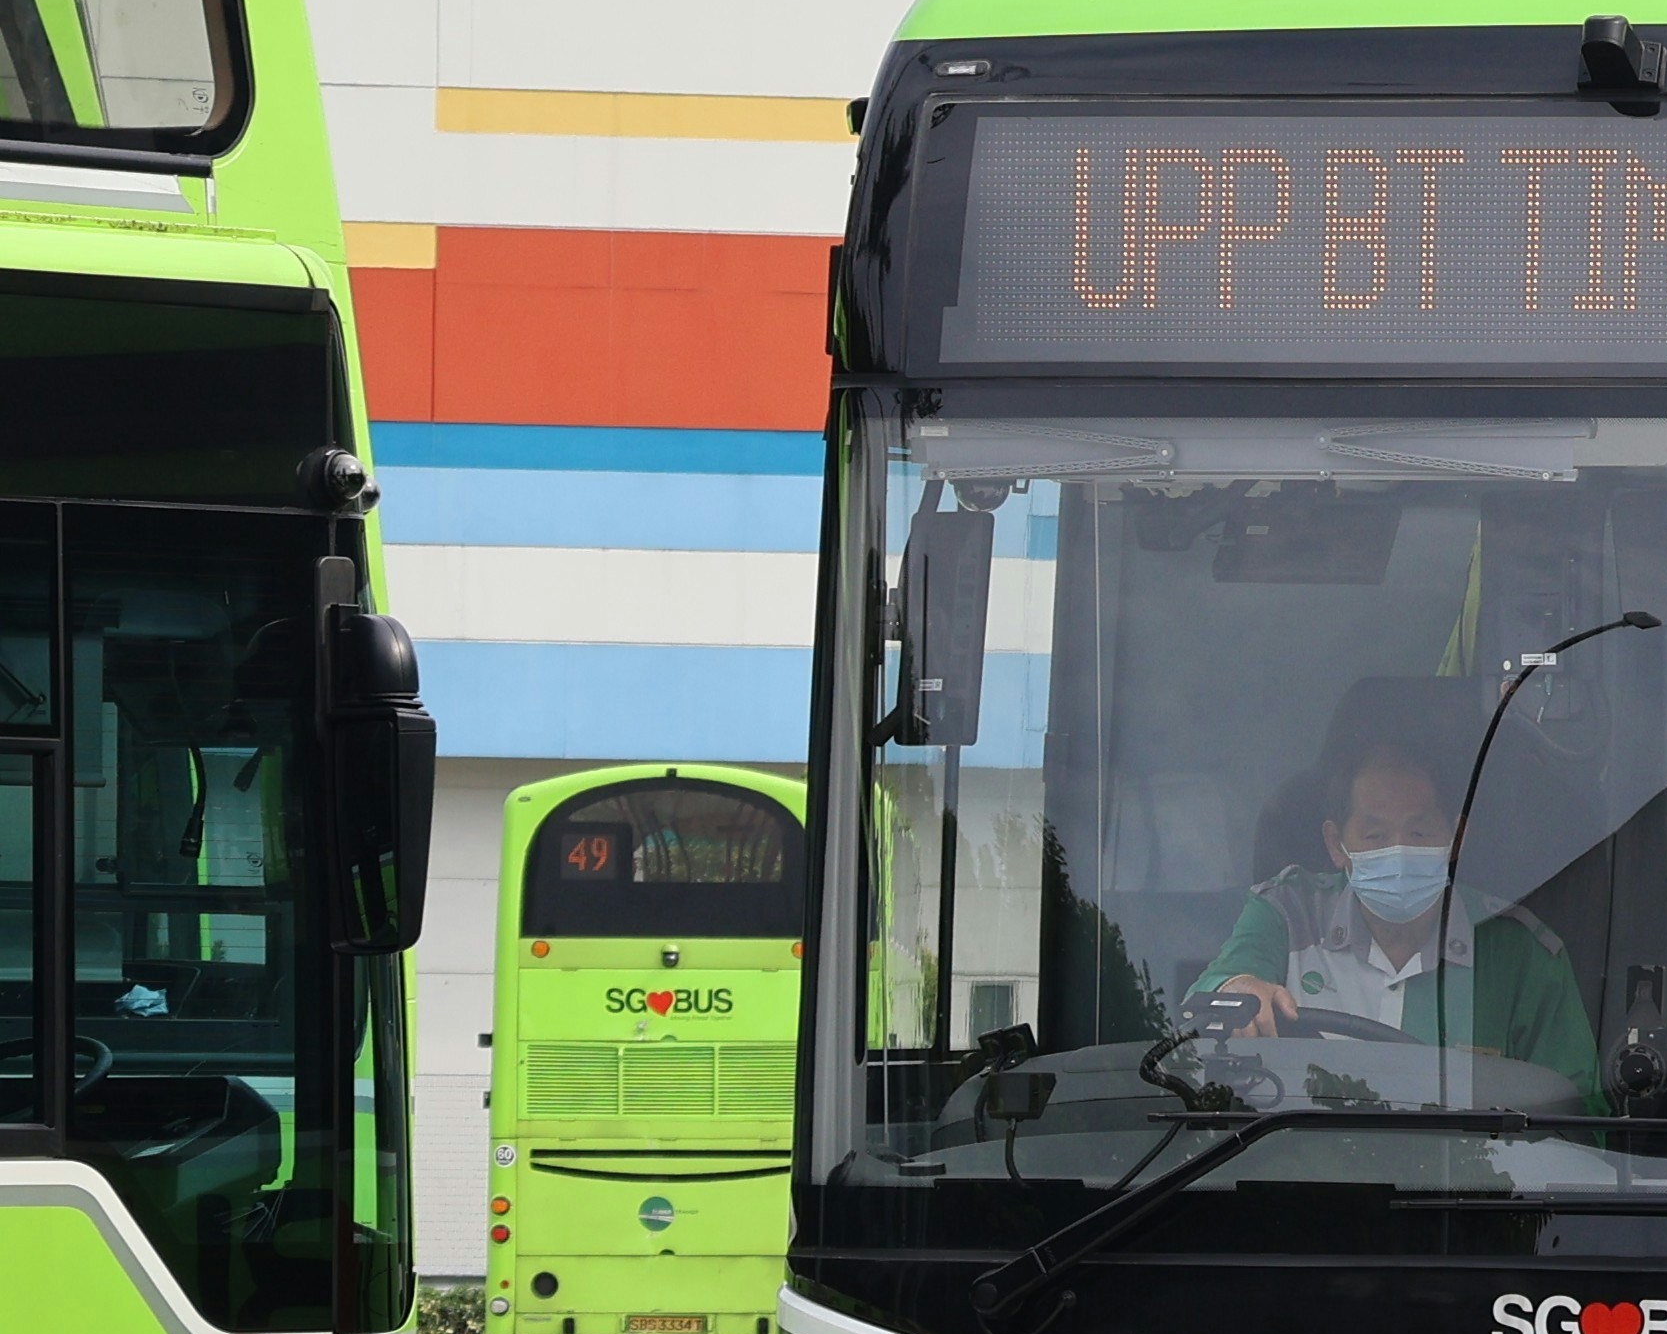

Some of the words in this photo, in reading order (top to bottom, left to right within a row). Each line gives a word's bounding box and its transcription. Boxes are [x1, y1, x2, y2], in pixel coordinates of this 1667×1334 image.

[1072, 146, 1291, 310] UPP
[1322, 147, 1464, 311] BT
[568, 837, 609, 872] 49
[497, 1148, 512, 1160] 60
